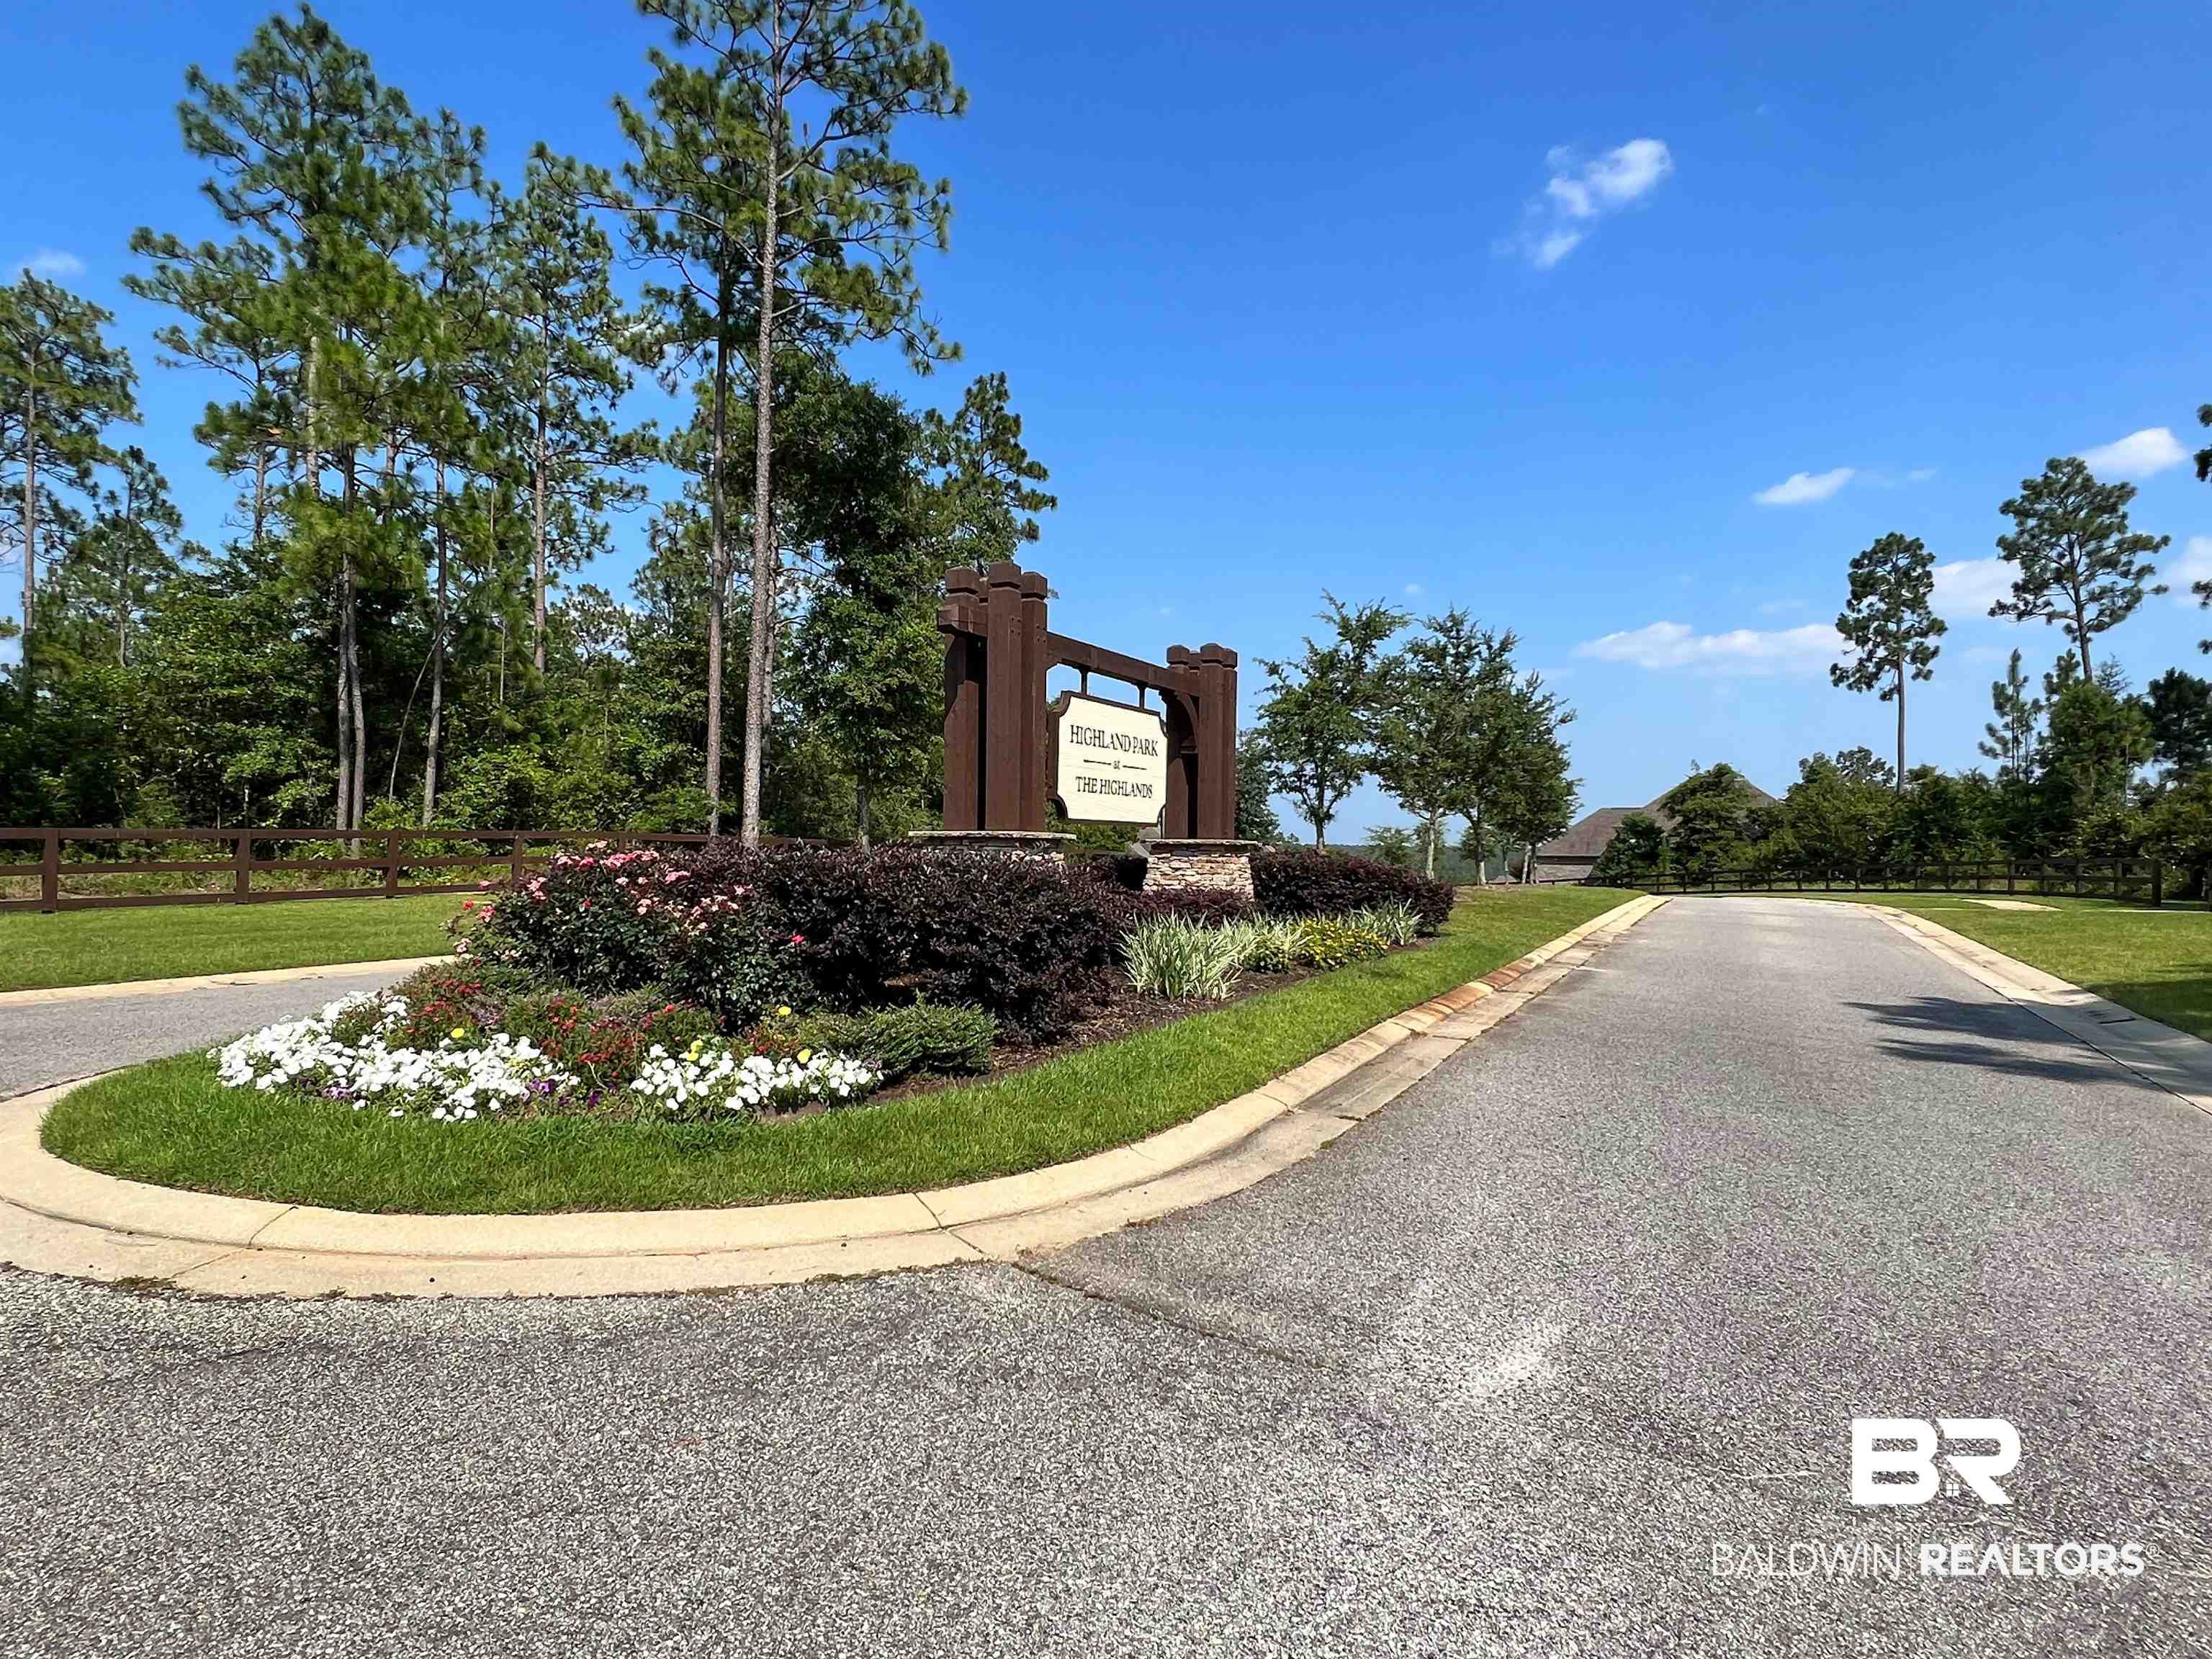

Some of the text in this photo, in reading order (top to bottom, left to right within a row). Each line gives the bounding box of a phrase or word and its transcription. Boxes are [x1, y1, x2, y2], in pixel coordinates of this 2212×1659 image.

[1069, 724, 1159, 757] HIGHLAND PARK
[1076, 776, 1154, 799] THE HIGHLANDS
